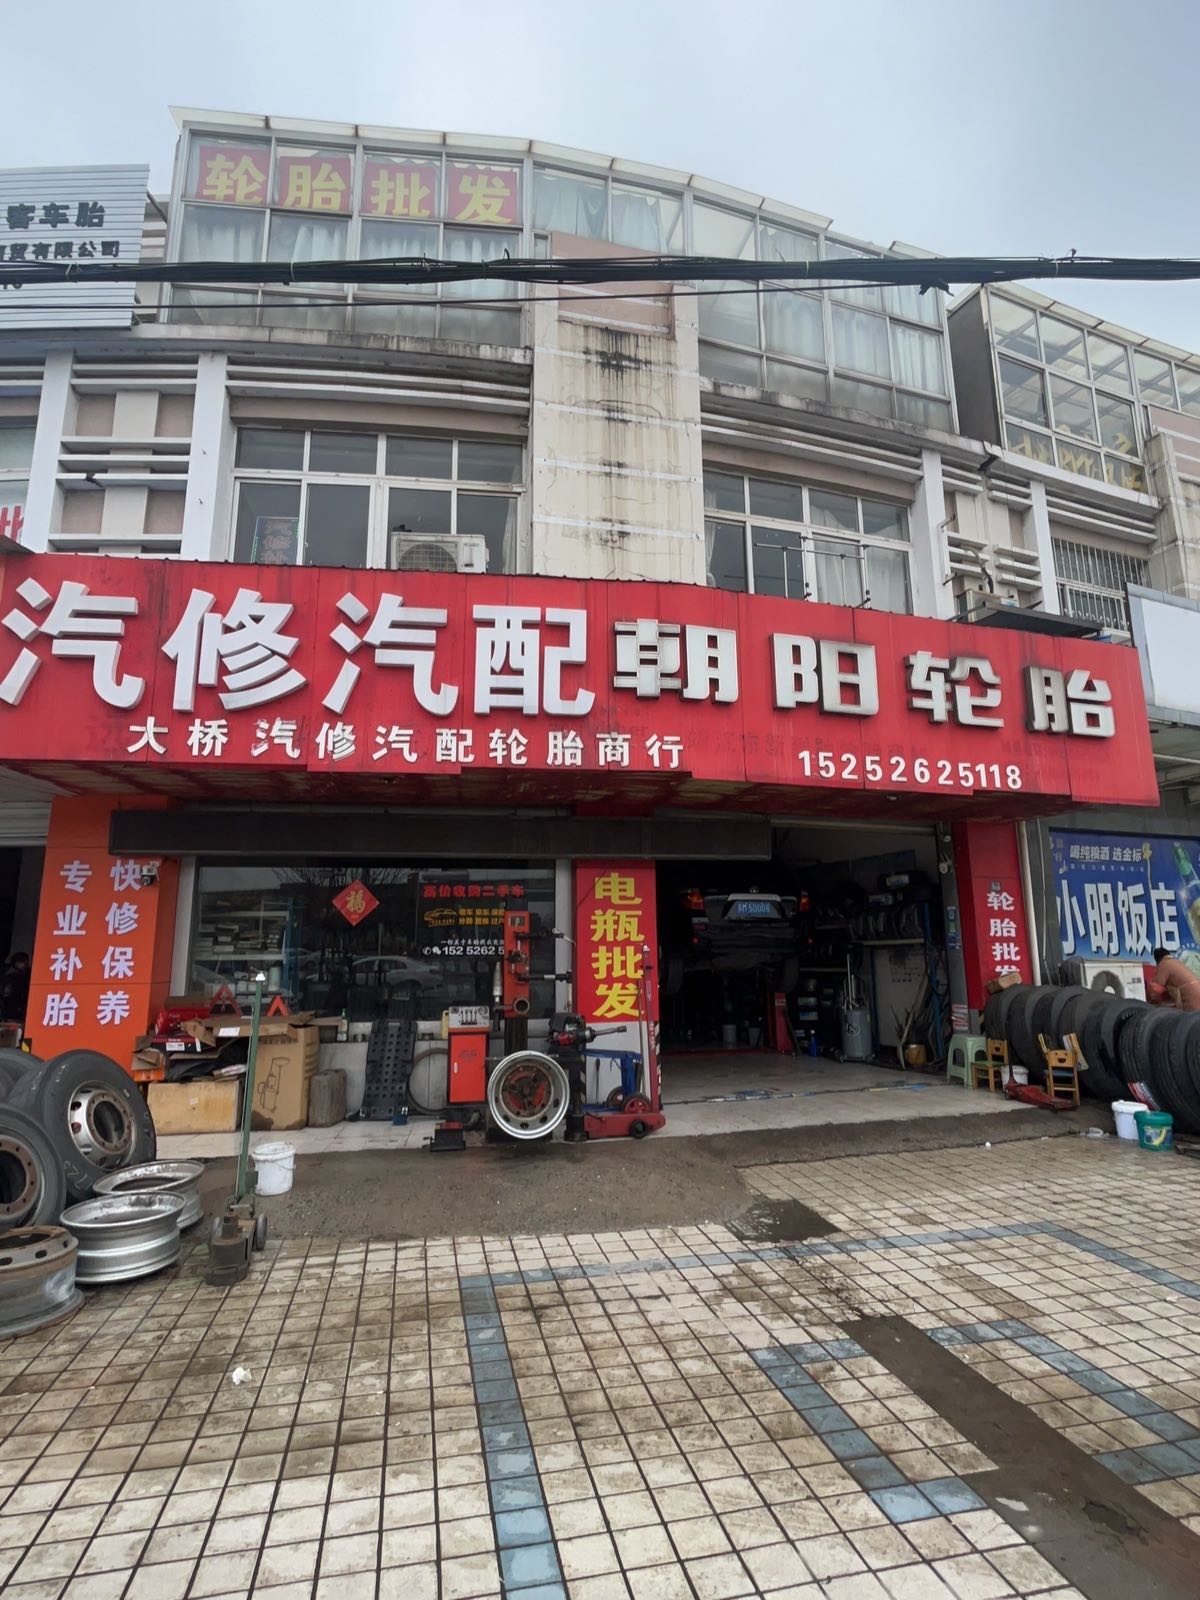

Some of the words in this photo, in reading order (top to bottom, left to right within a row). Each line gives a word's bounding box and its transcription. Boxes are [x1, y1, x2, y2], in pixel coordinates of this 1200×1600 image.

[202, 153, 512, 224] 轮胎批发
[0, 577, 597, 718] 汽修汽配
[612, 618, 1117, 739] 朝阳轮胎
[127, 716, 684, 771] 大桥汽修汽配轮胎商行
[798, 750, 1023, 791] 15252625118
[42, 860, 93, 1027] 专业补胎
[96, 859, 141, 1026] 快修保养
[442, 946, 464, 955] 152
[466, 946, 495, 955] 5262
[590, 872, 646, 1018] 电瓶批发
[1056, 879, 1182, 956] 小明饭店
